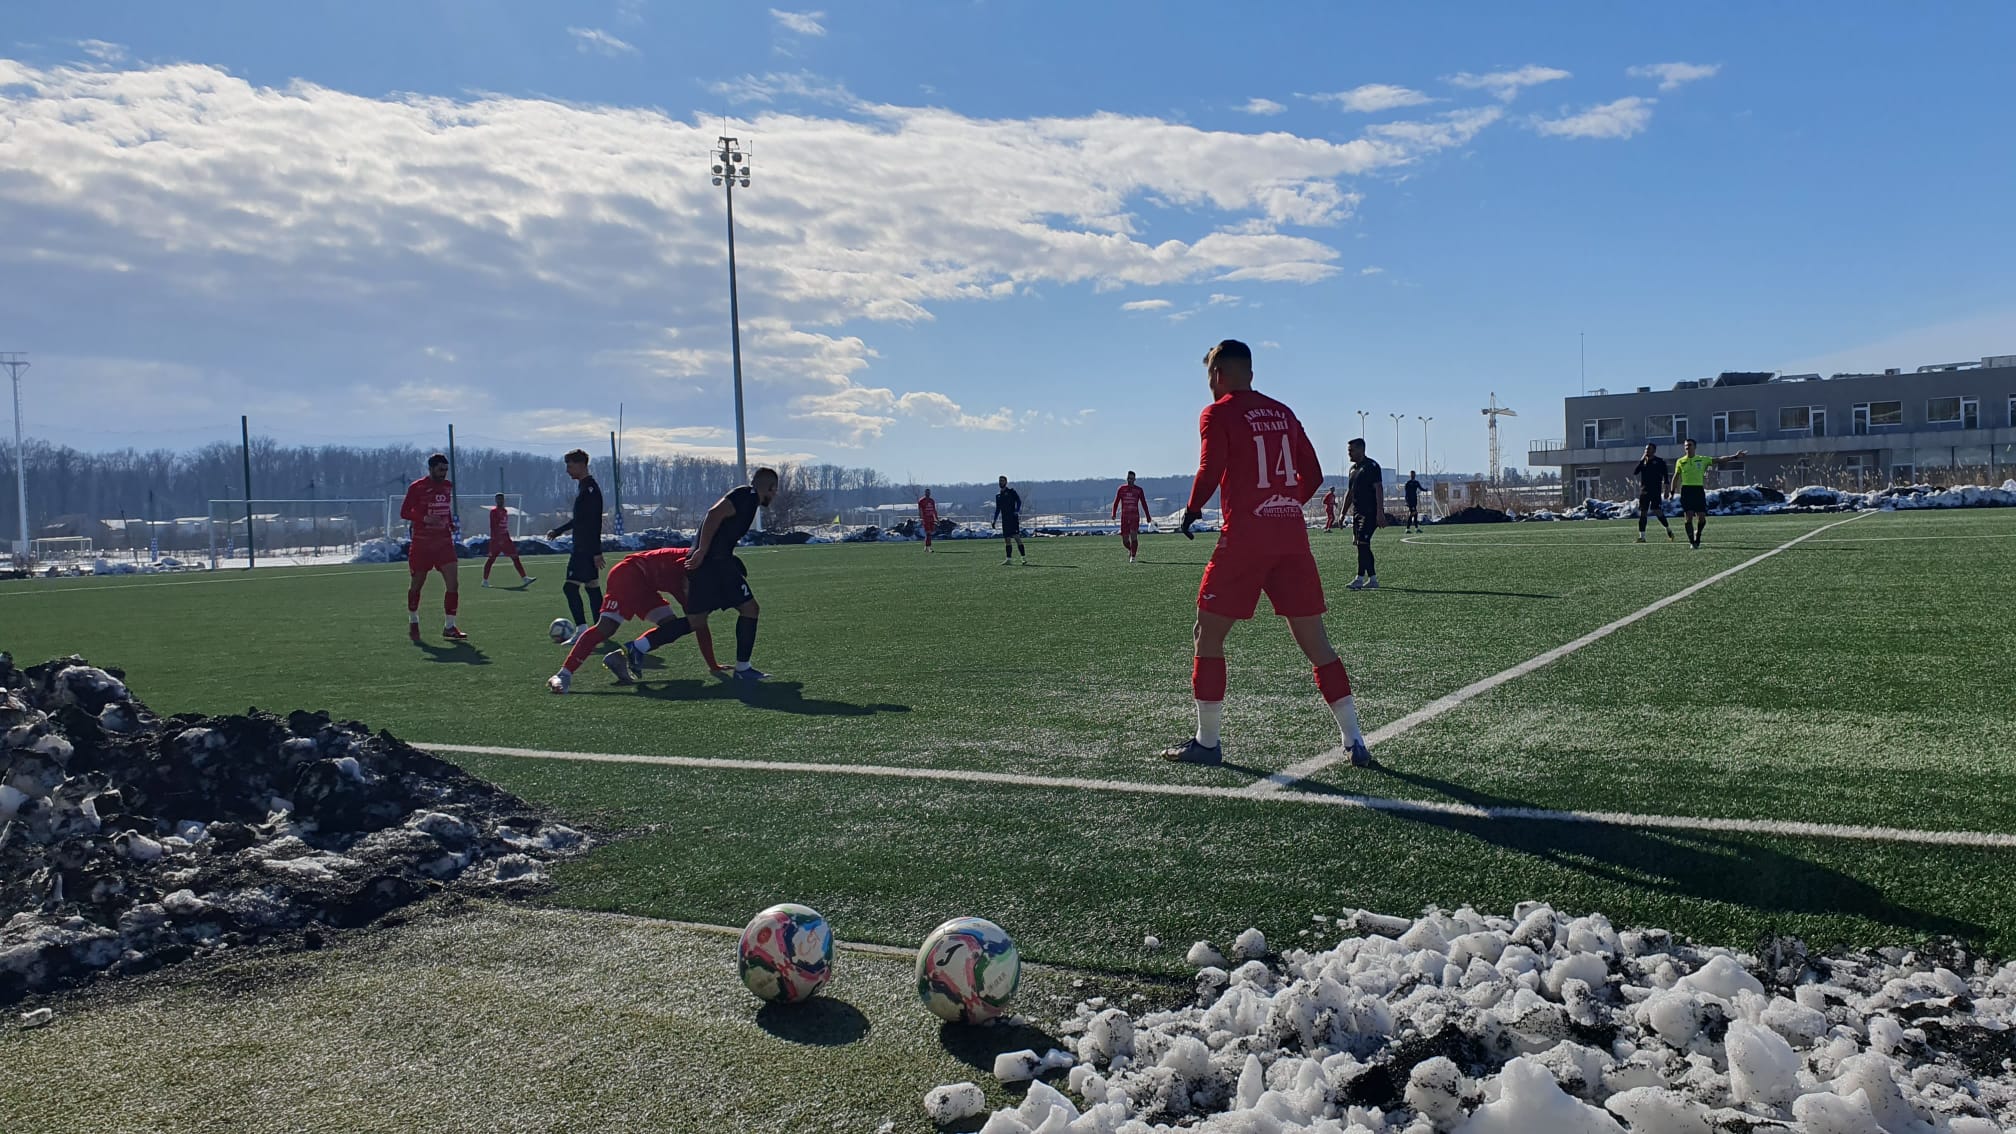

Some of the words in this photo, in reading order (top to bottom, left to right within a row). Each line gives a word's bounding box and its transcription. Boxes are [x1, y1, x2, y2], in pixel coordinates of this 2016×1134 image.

[1250, 420, 1289, 432] TUNARI
[1253, 434, 1298, 489] 14
[741, 584, 750, 597] 2
[606, 600, 618, 610] 19
